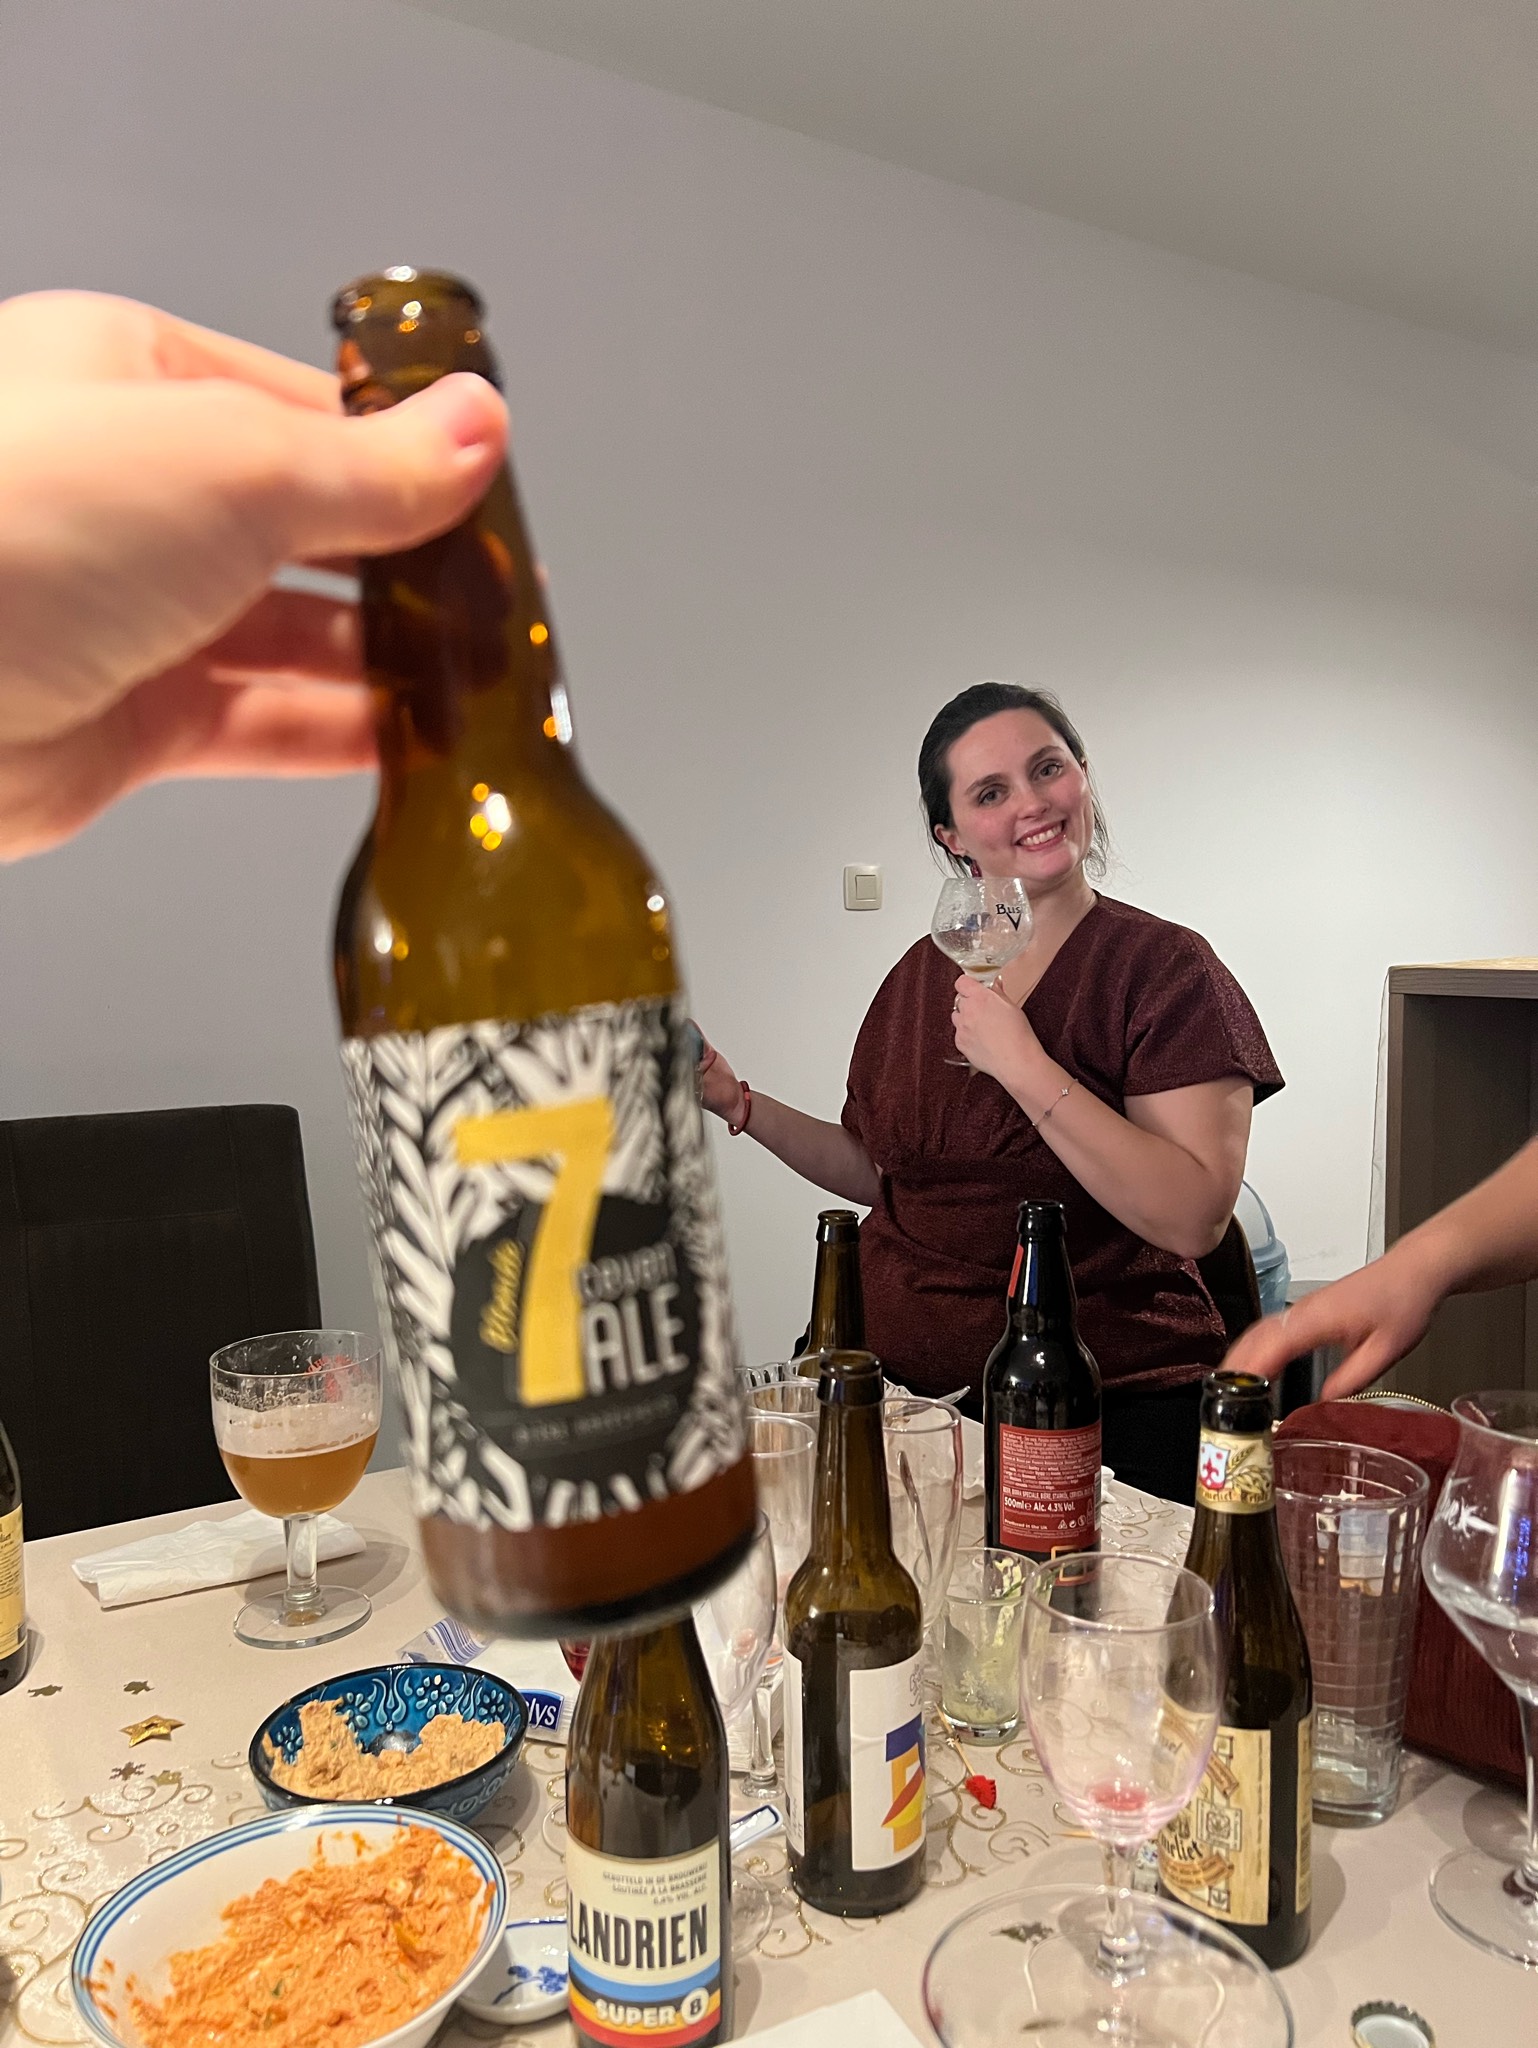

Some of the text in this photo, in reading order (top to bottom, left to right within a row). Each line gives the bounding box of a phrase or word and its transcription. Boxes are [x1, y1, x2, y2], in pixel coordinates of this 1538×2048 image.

[454, 1092, 616, 1408] 7
[583, 1282, 690, 1397] ALE
[1004, 1496, 1024, 1509] 500ml
[1033, 1502, 1047, 1512] Alc.
[1047, 1502, 1063, 1512] 4.3%
[1063, 1501, 1076, 1512] Vol.
[525, 1697, 557, 1729] lys
[595, 2000, 676, 2027] SUPER
